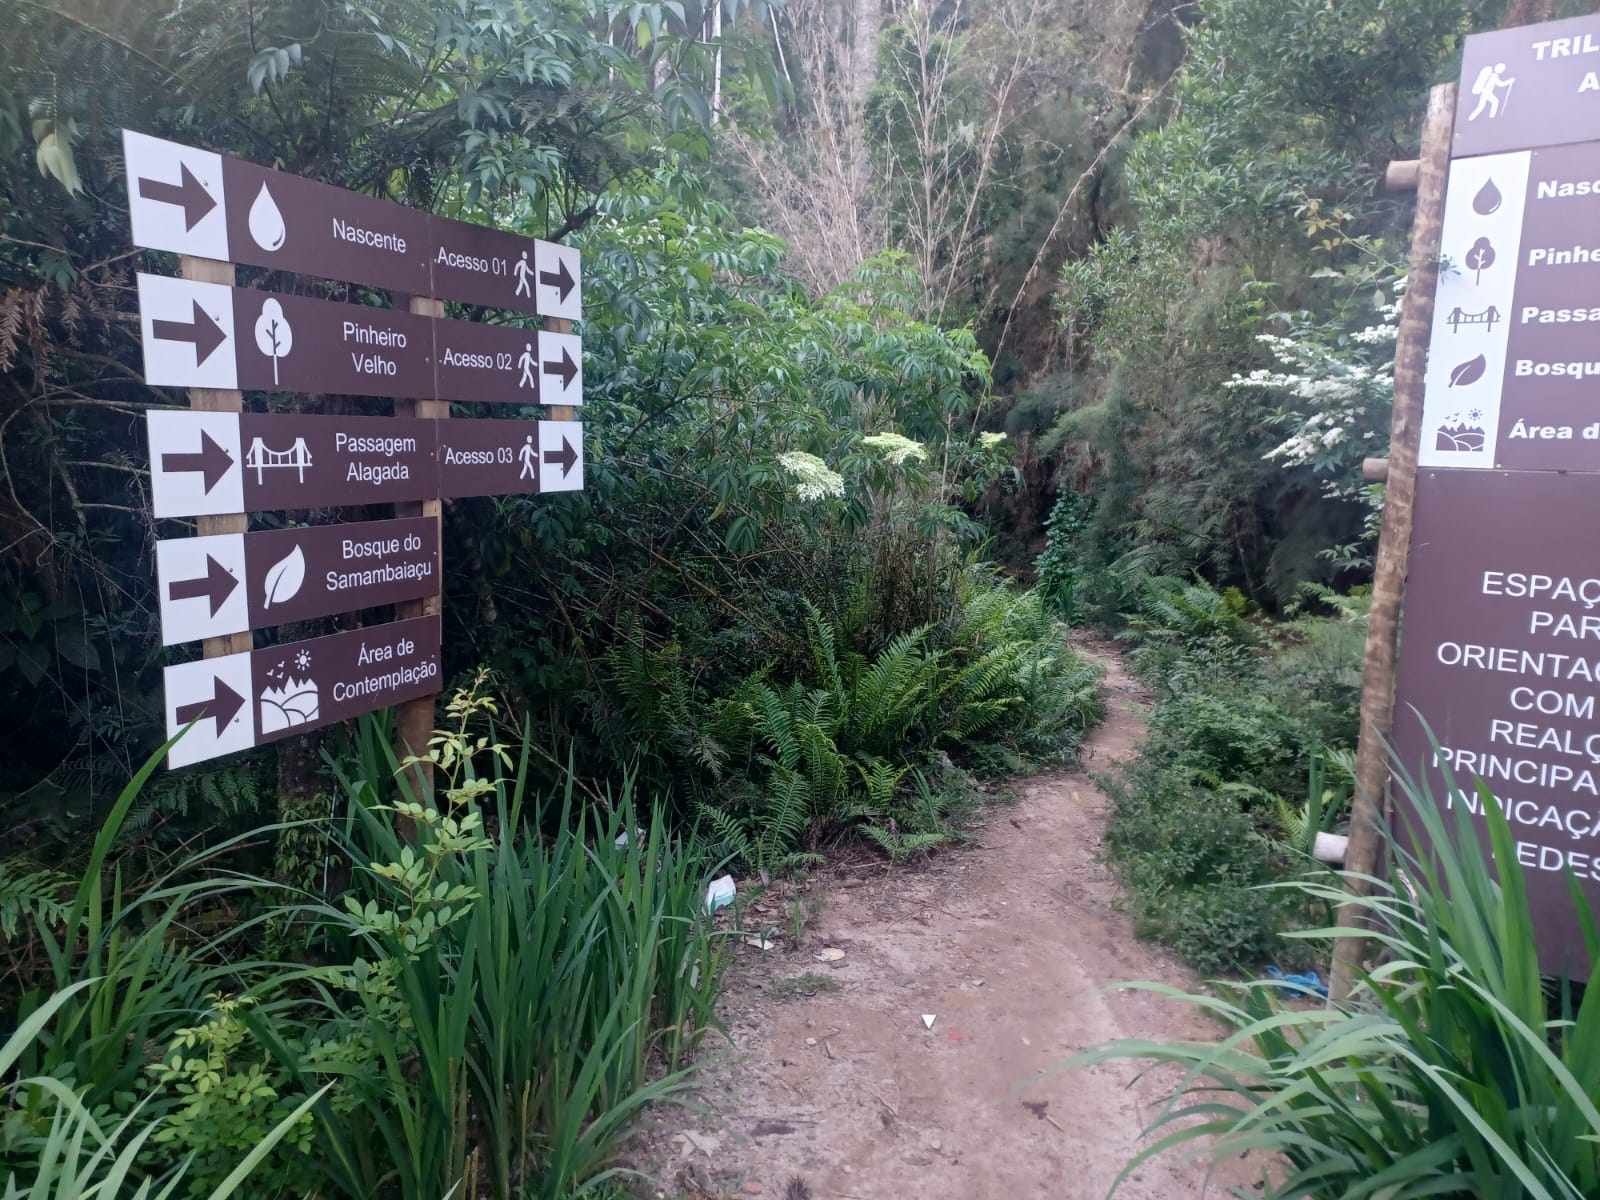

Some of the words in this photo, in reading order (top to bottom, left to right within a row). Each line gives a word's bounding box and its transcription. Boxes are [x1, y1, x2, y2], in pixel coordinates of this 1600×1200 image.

[1532, 34, 1600, 60] TRIL
[1577, 72, 1600, 93] A
[332, 217, 407, 253] Nascente
[437, 246, 489, 273] Acesso
[492, 257, 507, 276] 01
[1521, 306, 1600, 324] Passa
[343, 321, 407, 348] Pinheiro
[352, 352, 397, 376] Velho
[443, 347, 493, 369] Acesso
[496, 352, 513, 370] 02
[1515, 359, 1600, 379] Bosqu
[1508, 418, 1573, 439] Área
[1582, 422, 1600, 439] d
[335, 433, 416, 456] Passagem
[445, 447, 494, 465] Acesso
[497, 447, 513, 463] 03
[346, 462, 409, 485] Alagada
[342, 536, 400, 559] Bosque
[403, 533, 421, 551] do
[326, 560, 432, 591] Samambaiaçu
[1482, 571, 1600, 609] ESPAÇ
[358, 642, 393, 666] Área
[395, 638, 415, 657] de
[1437, 641, 1600, 682] ORIENTA
[333, 661, 437, 702] Contemplação
[1510, 687, 1595, 720] COM
[1432, 746, 1599, 795] PRINCIPA
